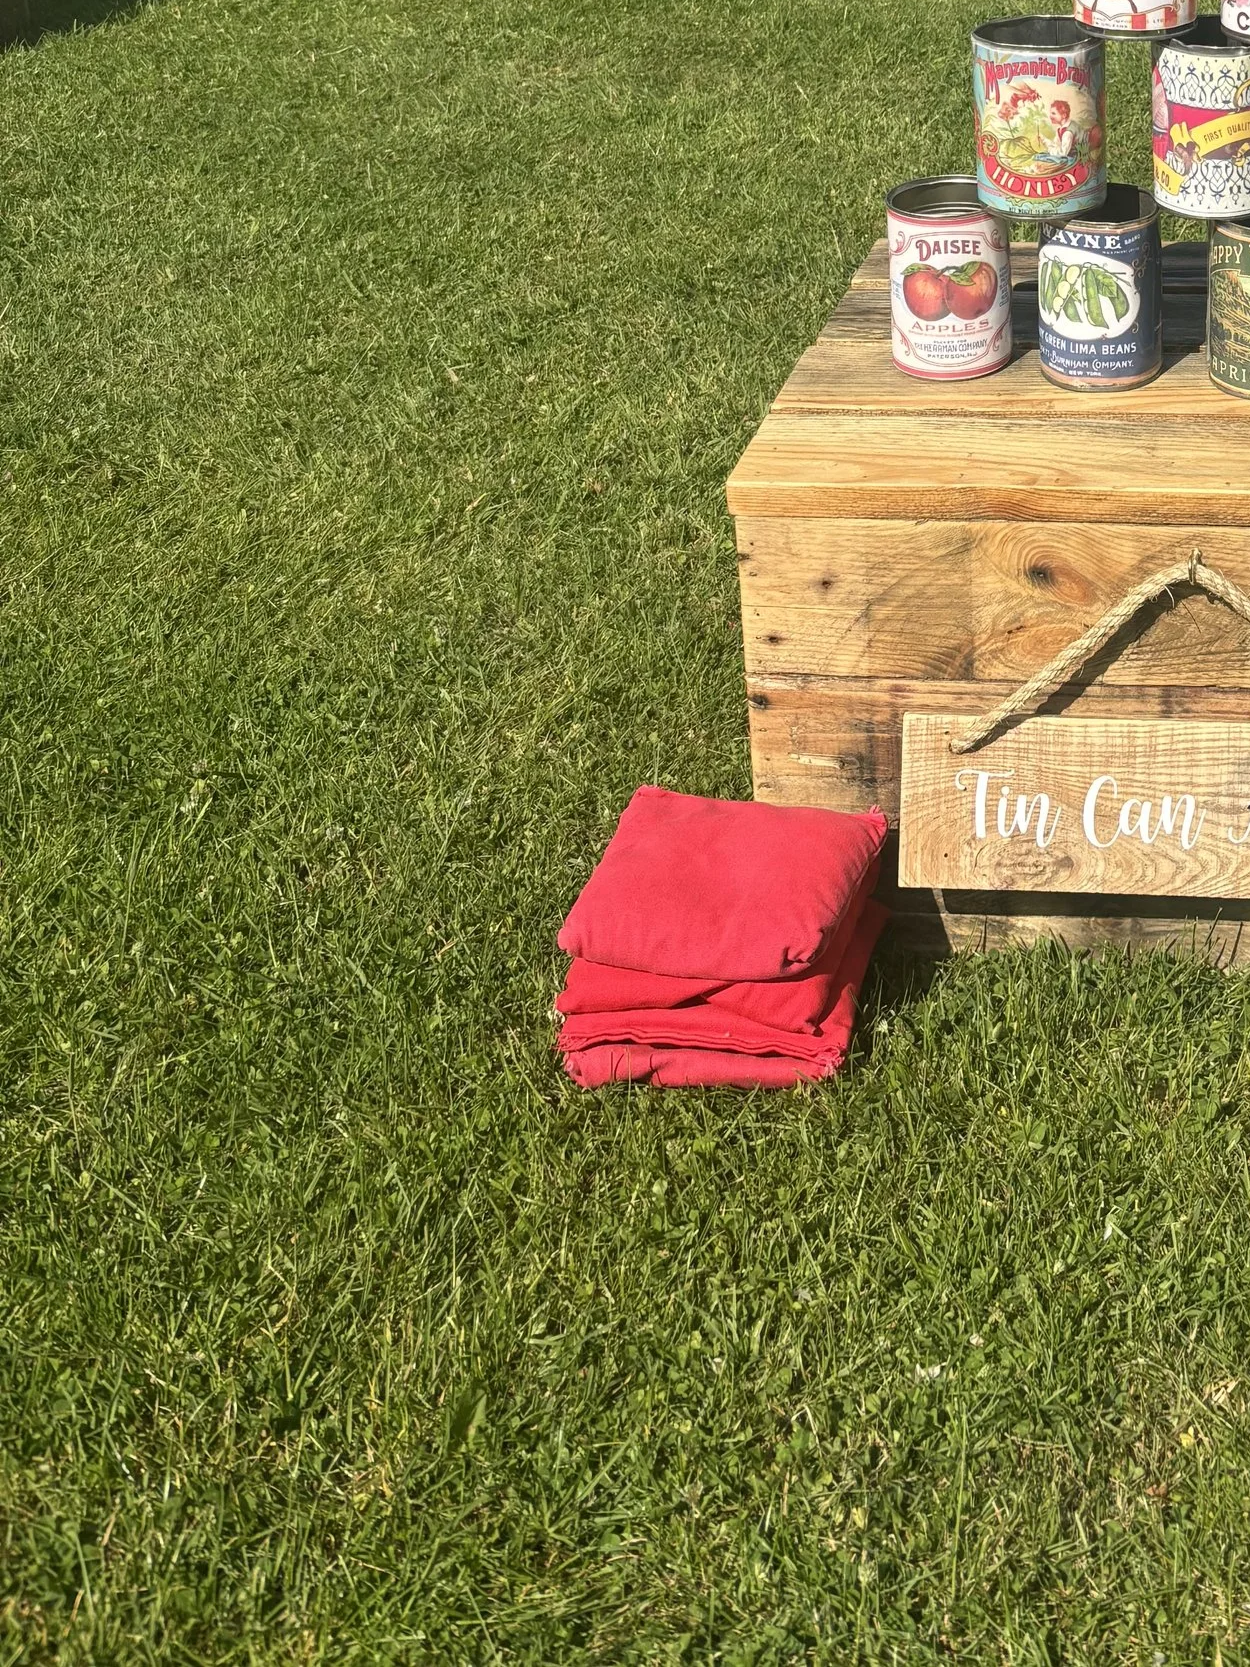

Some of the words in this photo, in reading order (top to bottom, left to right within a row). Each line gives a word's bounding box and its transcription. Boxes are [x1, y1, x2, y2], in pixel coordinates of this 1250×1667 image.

[1203, 129, 1223, 143] FIRST
[992, 166, 1083, 197] HONEY
[1042, 222, 1122, 250] WAYNE
[915, 239, 982, 262] DAISEE
[1211, 242, 1244, 265] APPY
[911, 318, 990, 333] APPLES
[958, 338, 988, 352] COMPANY
[1044, 332, 1067, 352] GREEN
[1070, 341, 1097, 355] LIMA
[1101, 342, 1137, 355] BEANS
[955, 768, 1062, 848] Tin
[1082, 775, 1208, 850] Can
